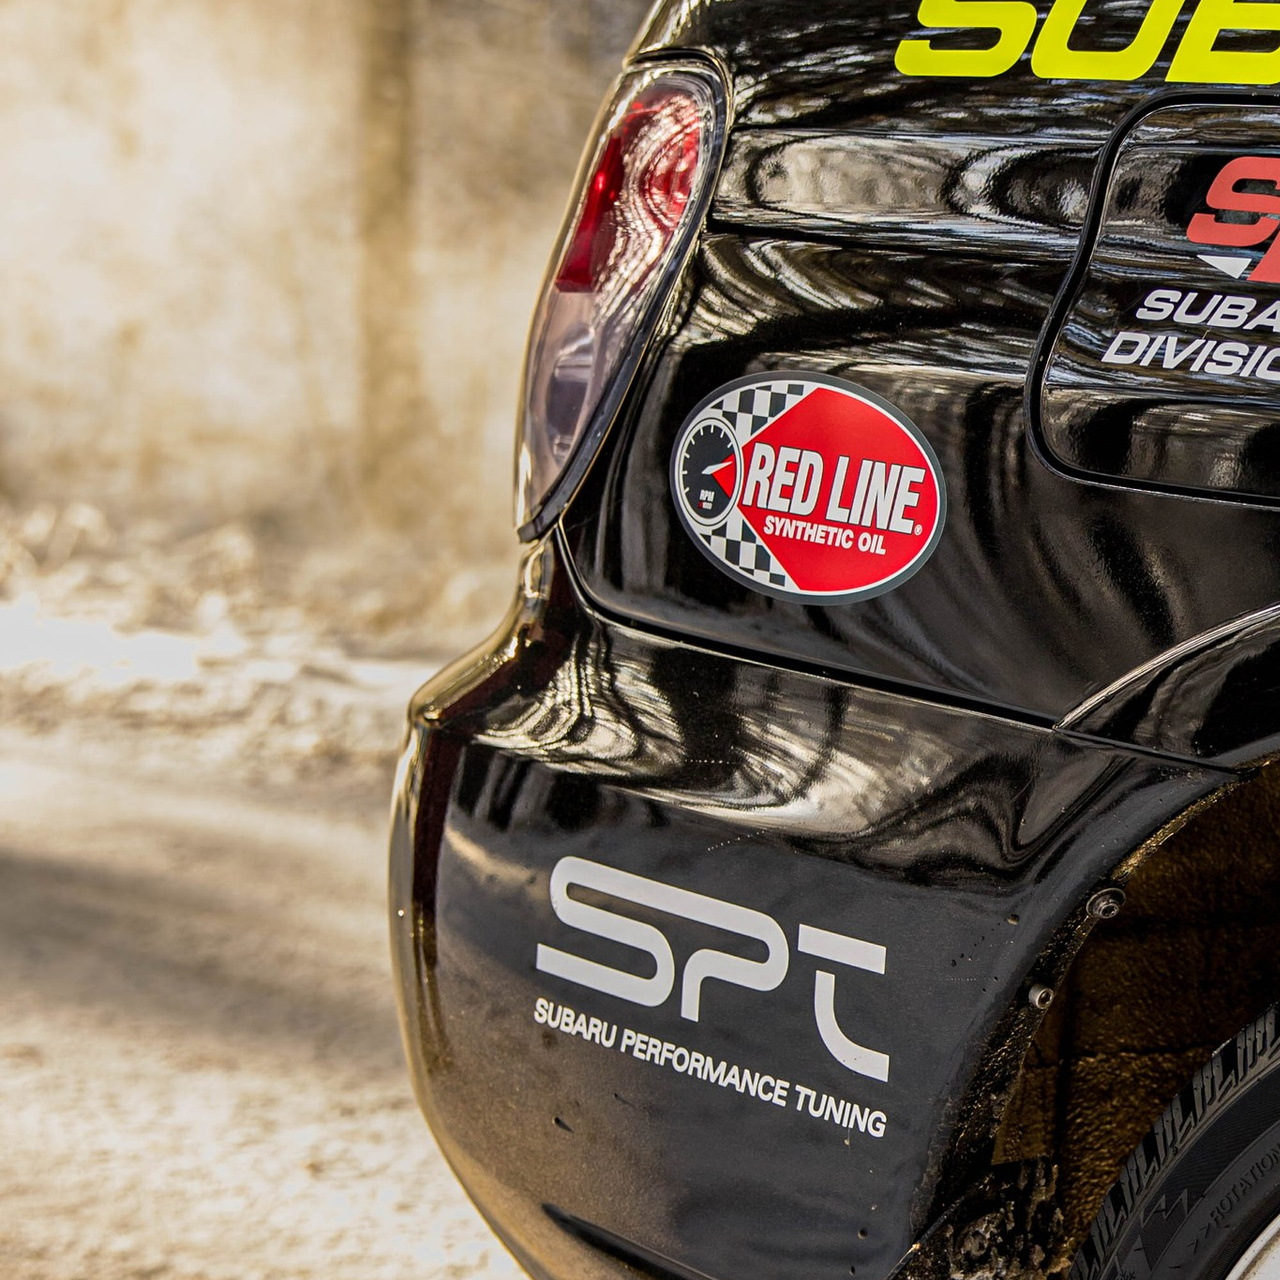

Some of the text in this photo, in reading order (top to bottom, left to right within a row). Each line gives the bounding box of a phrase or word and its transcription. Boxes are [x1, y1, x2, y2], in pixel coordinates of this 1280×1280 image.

[742, 442, 926, 534] RED LINE
[763, 515, 886, 555] SYNTHETIC OIL
[536, 856, 890, 1082] SPT
[534, 998, 888, 1139] SUBARU PERFORMANCE TUNING
